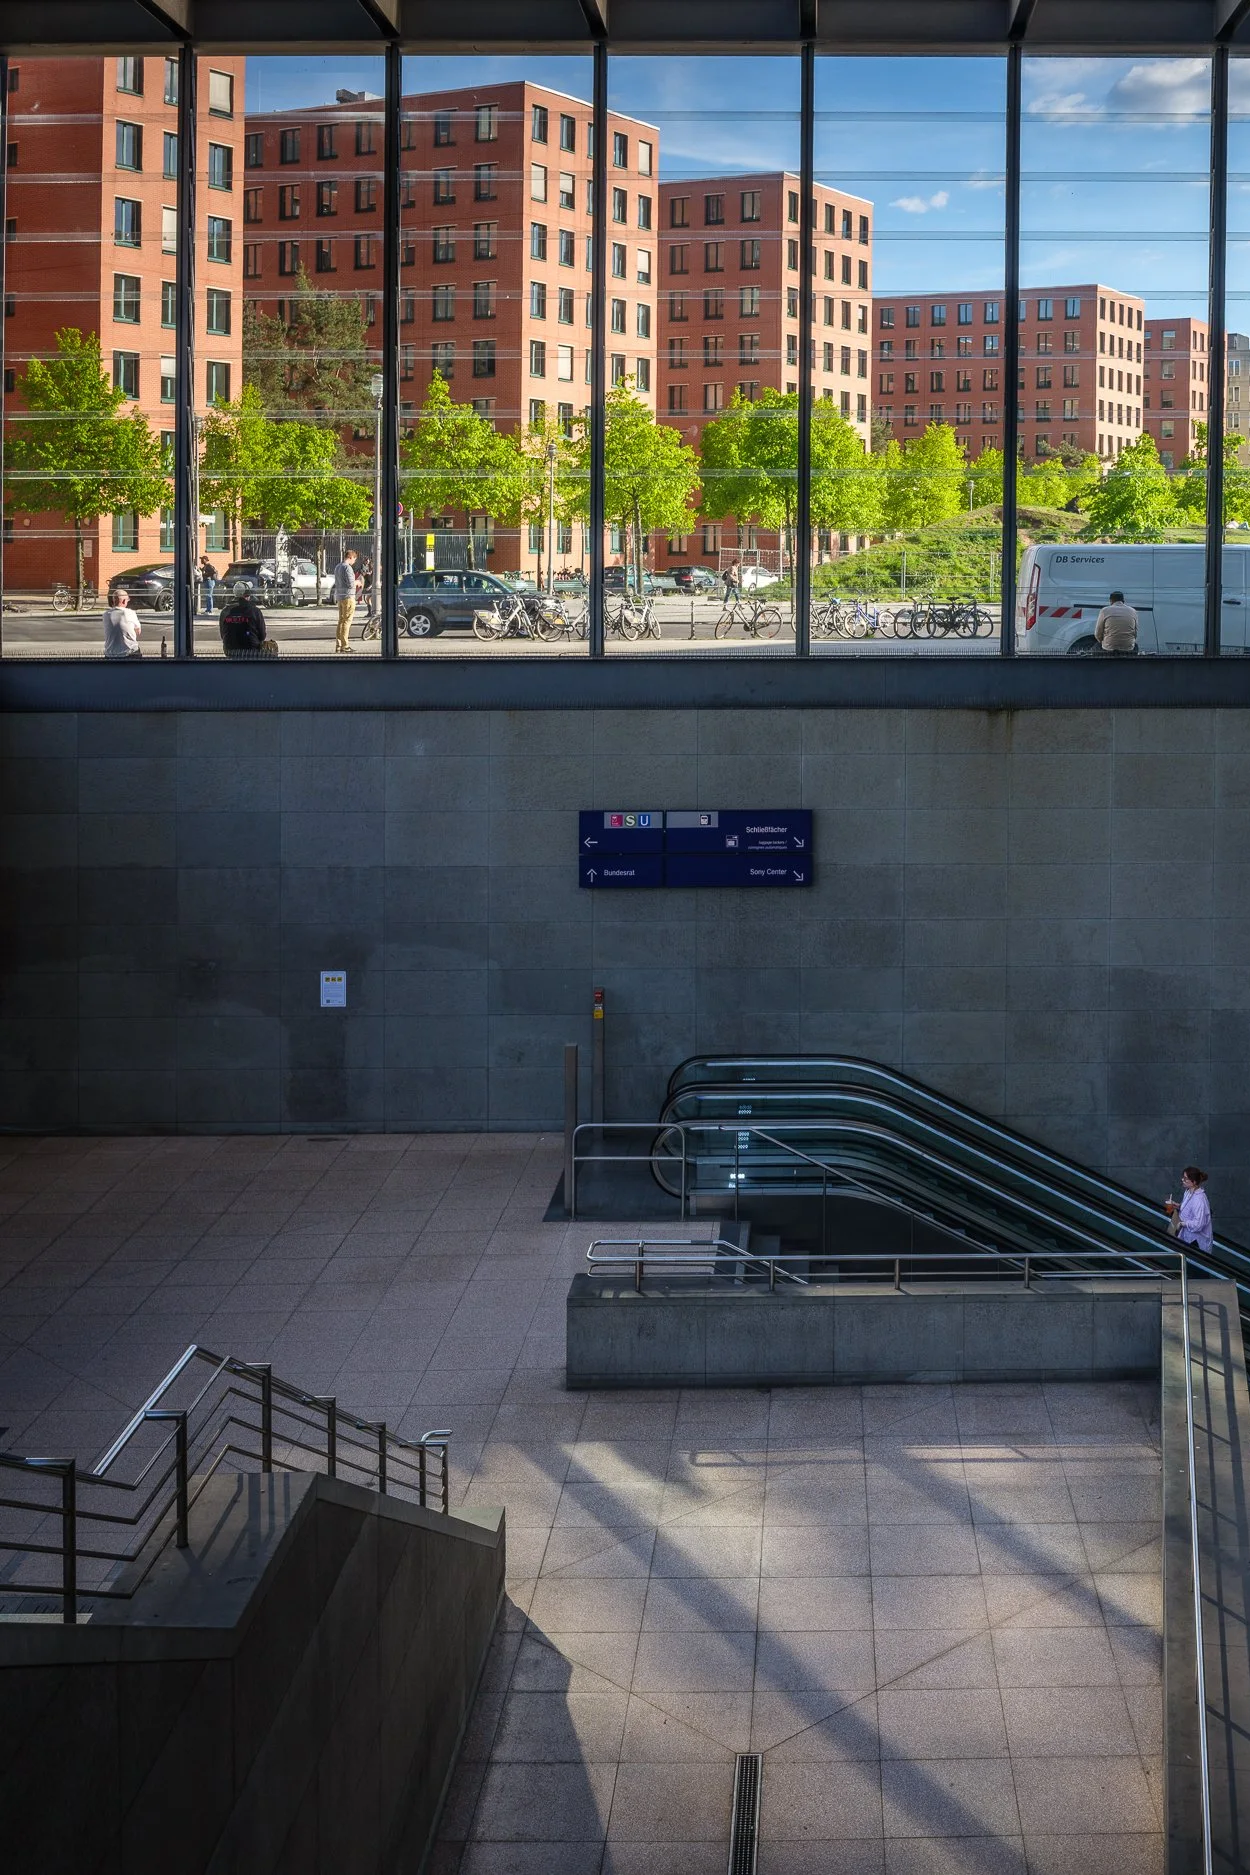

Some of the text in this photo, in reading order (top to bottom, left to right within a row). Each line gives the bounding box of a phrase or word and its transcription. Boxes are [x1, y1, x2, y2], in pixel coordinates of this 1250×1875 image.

[626, 815, 635, 826] S
[640, 815, 649, 826] U
[750, 868, 765, 877] Sony
